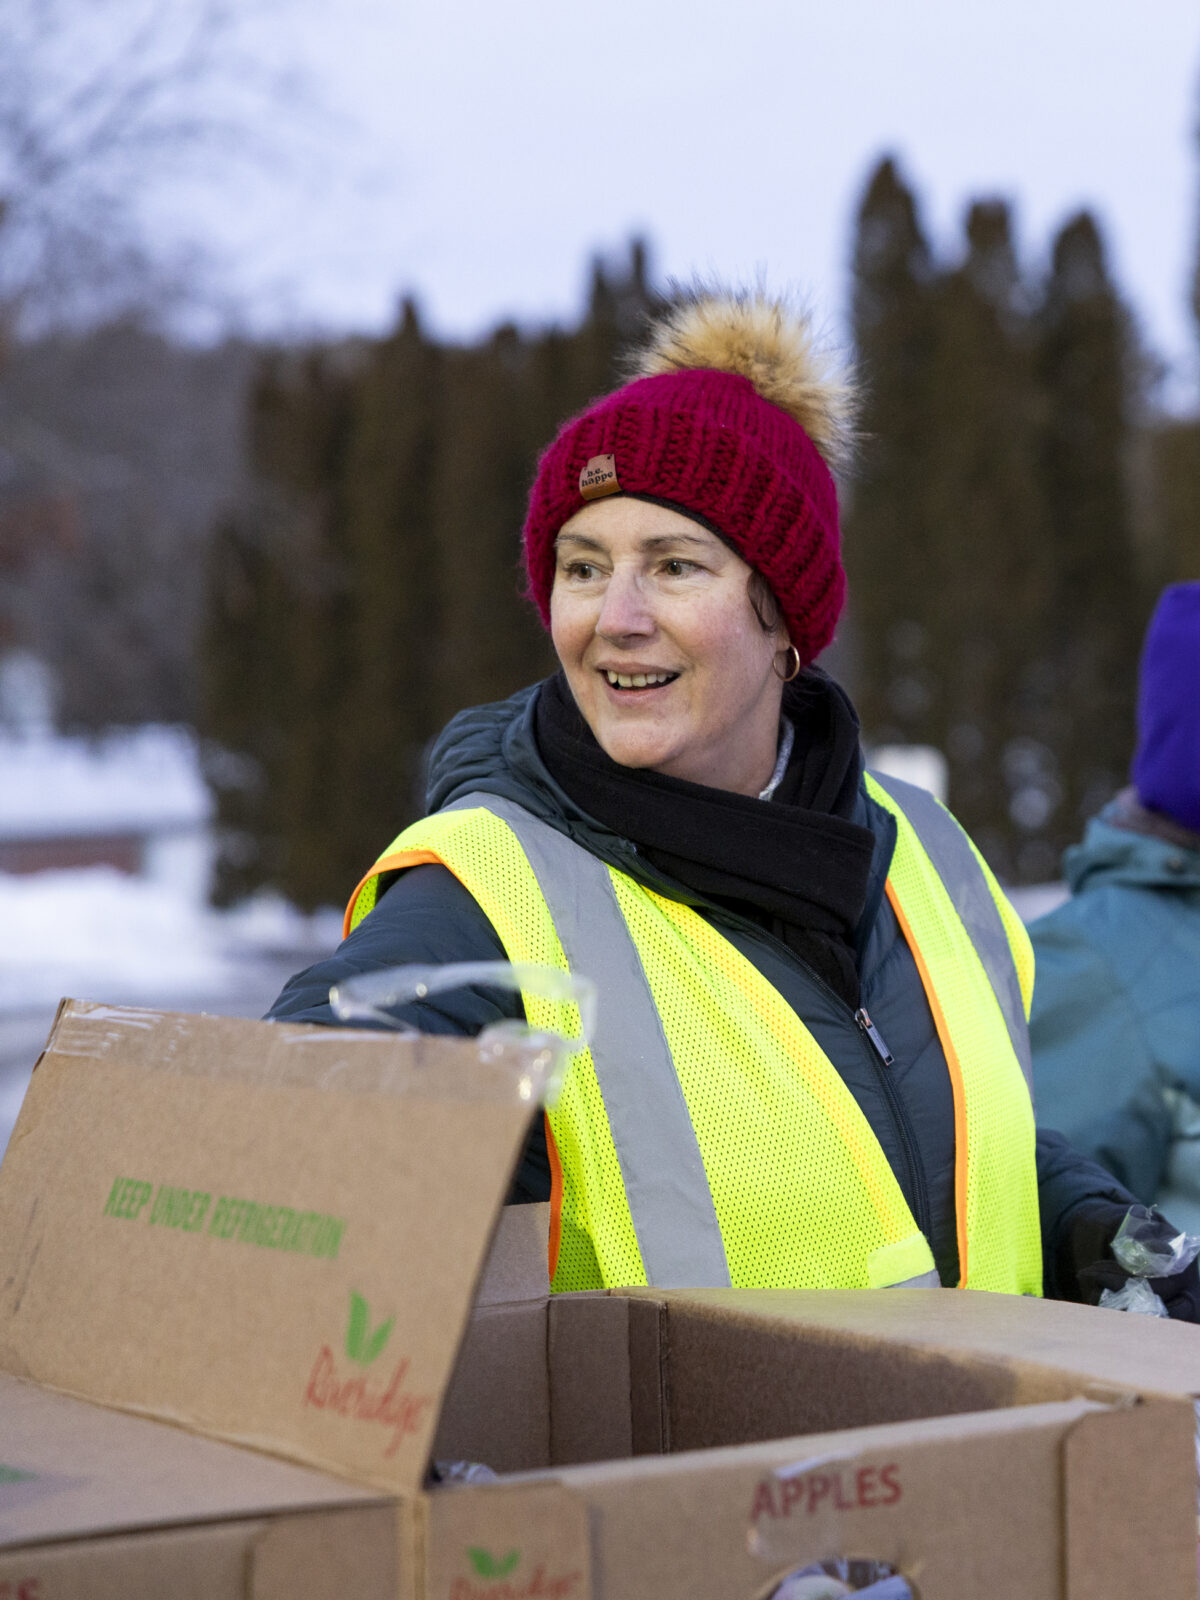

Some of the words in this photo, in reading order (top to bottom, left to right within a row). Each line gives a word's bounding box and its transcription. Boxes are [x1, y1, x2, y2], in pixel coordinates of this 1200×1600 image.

[103, 1176, 152, 1220] KEEP
[150, 1184, 211, 1233] UNDER
[752, 1464, 902, 1522] APPLES
